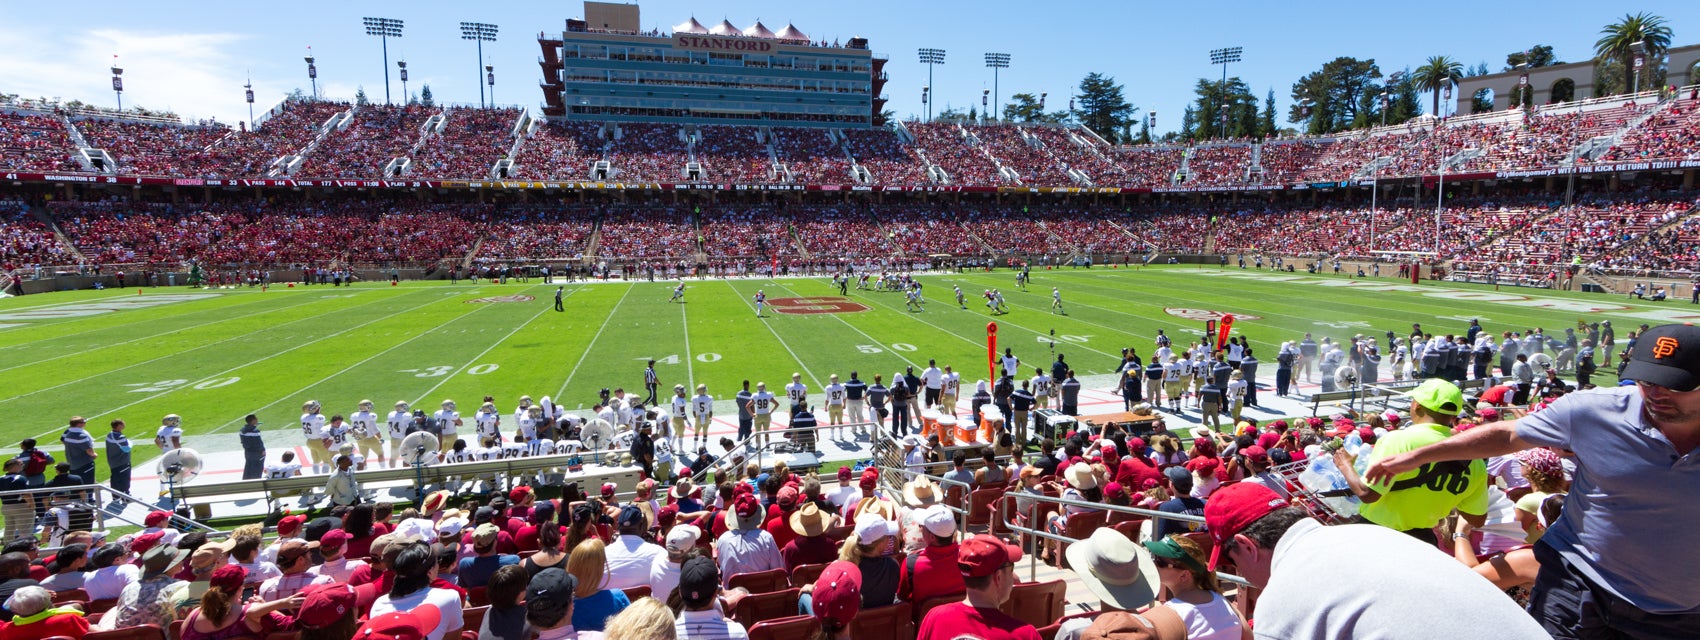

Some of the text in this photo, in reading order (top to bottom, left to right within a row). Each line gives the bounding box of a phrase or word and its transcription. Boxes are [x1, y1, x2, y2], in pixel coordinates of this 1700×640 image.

[679, 36, 771, 52] STANFORD
[1496, 168, 1556, 179] @TyMontgomery2
[1594, 164, 1614, 173] KICK
[1616, 162, 1649, 171] RETURN
[1652, 336, 1679, 359] SF
[832, 390, 842, 400] 97
[946, 428, 954, 437] G
